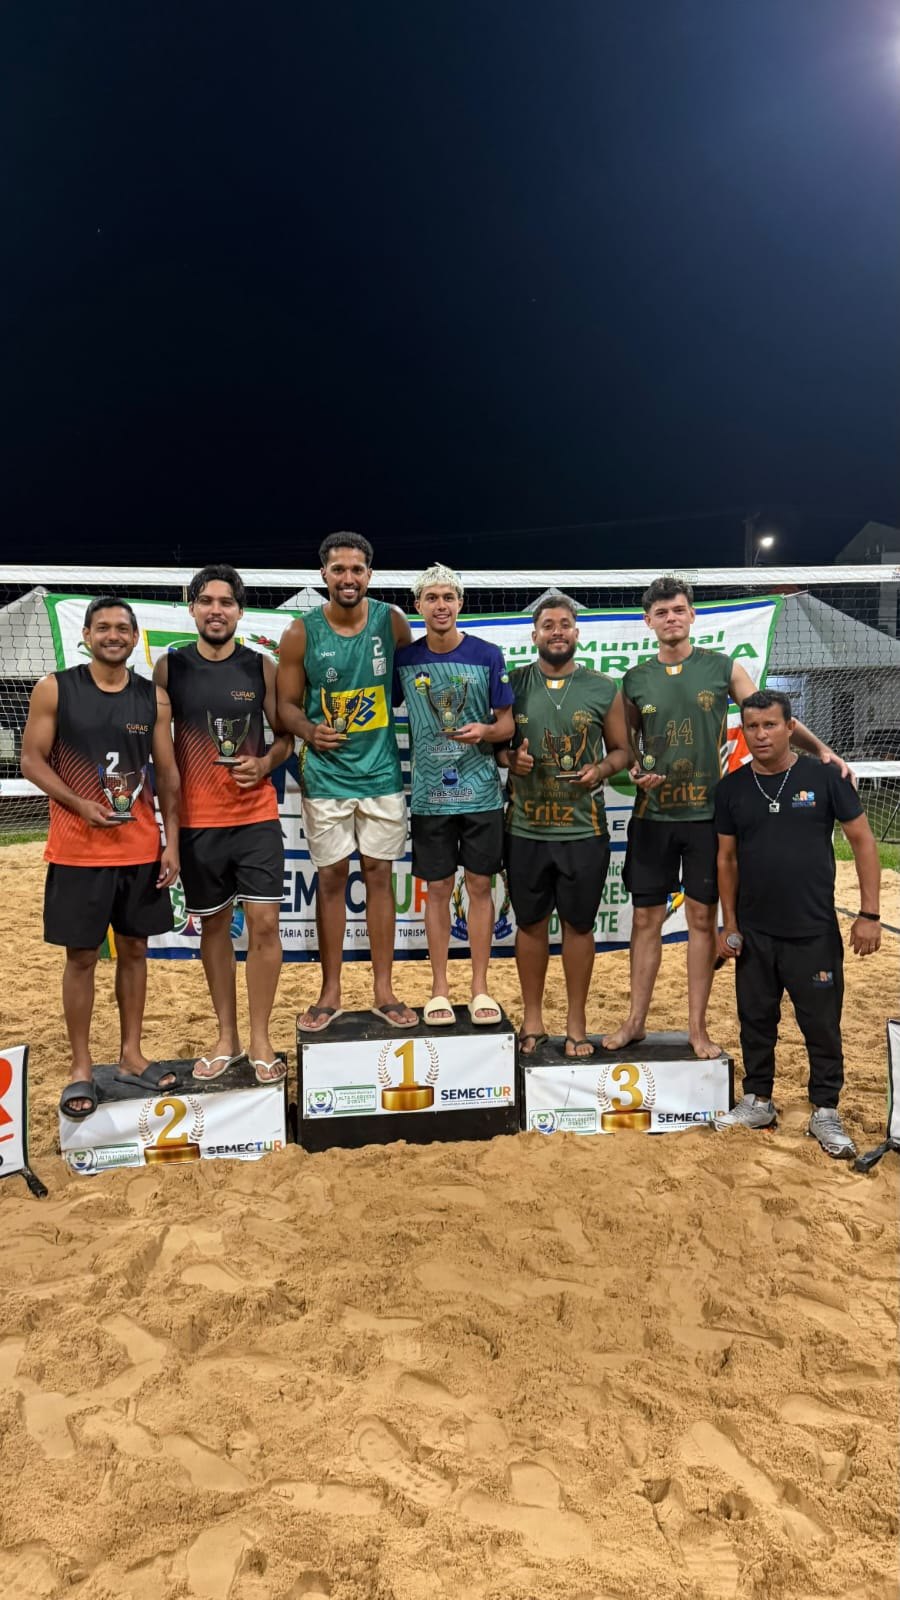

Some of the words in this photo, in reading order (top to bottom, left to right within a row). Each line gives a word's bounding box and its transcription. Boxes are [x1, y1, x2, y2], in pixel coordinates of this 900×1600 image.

[371, 636, 383, 656] 2
[666, 717, 693, 747] 14
[105, 751, 120, 776] 2
[660, 782, 708, 803] Fritz
[524, 800, 575, 822] Fritz
[398, 929, 426, 938] TURISM
[394, 1040, 419, 1088] 1
[440, 1086, 511, 1101] SEMECTUR
[611, 1063, 644, 1112] 3
[154, 1098, 189, 1146] 2
[207, 1139, 283, 1154] SEMECTUR
